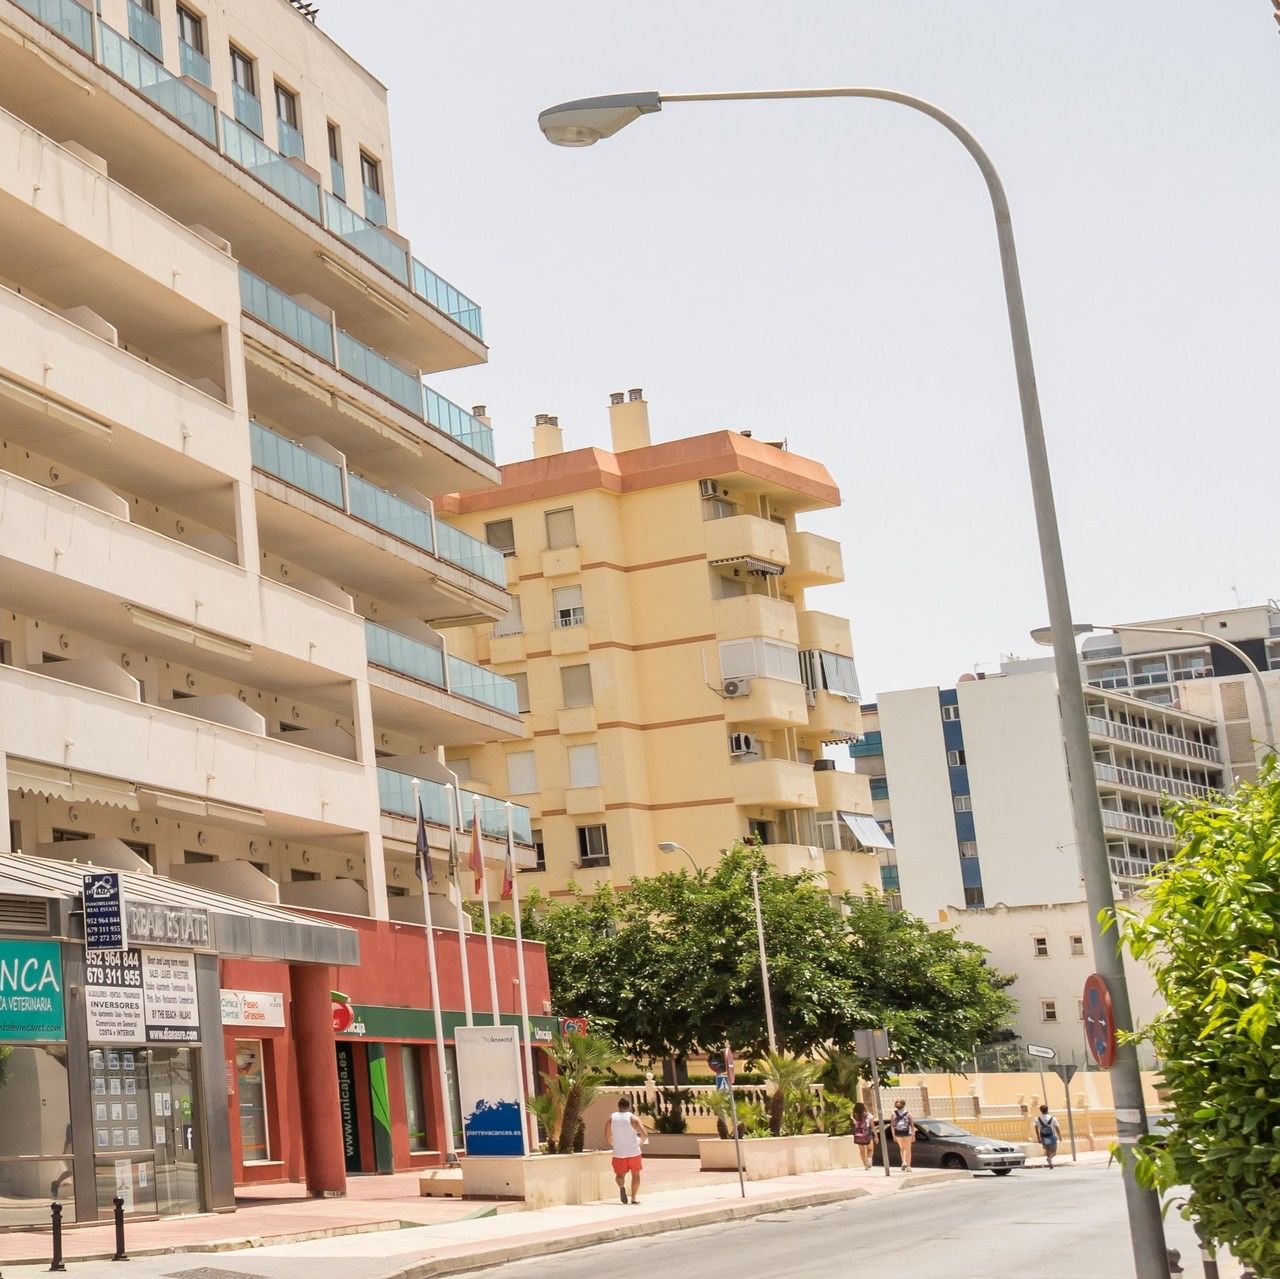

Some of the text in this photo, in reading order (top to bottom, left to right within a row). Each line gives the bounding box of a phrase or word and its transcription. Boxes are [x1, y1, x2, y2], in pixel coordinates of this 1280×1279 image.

[130, 908, 208, 945] REAL ESTATE
[85, 950, 140, 968] 952 964 844
[86, 968, 140, 986] 679 311 955
[8, 996, 53, 1012] VETERINARIA
[90, 1001, 140, 1010] INVERSORES
[222, 1010, 239, 1018] Dental
[339, 1052, 354, 1157] www.unicaja.es
